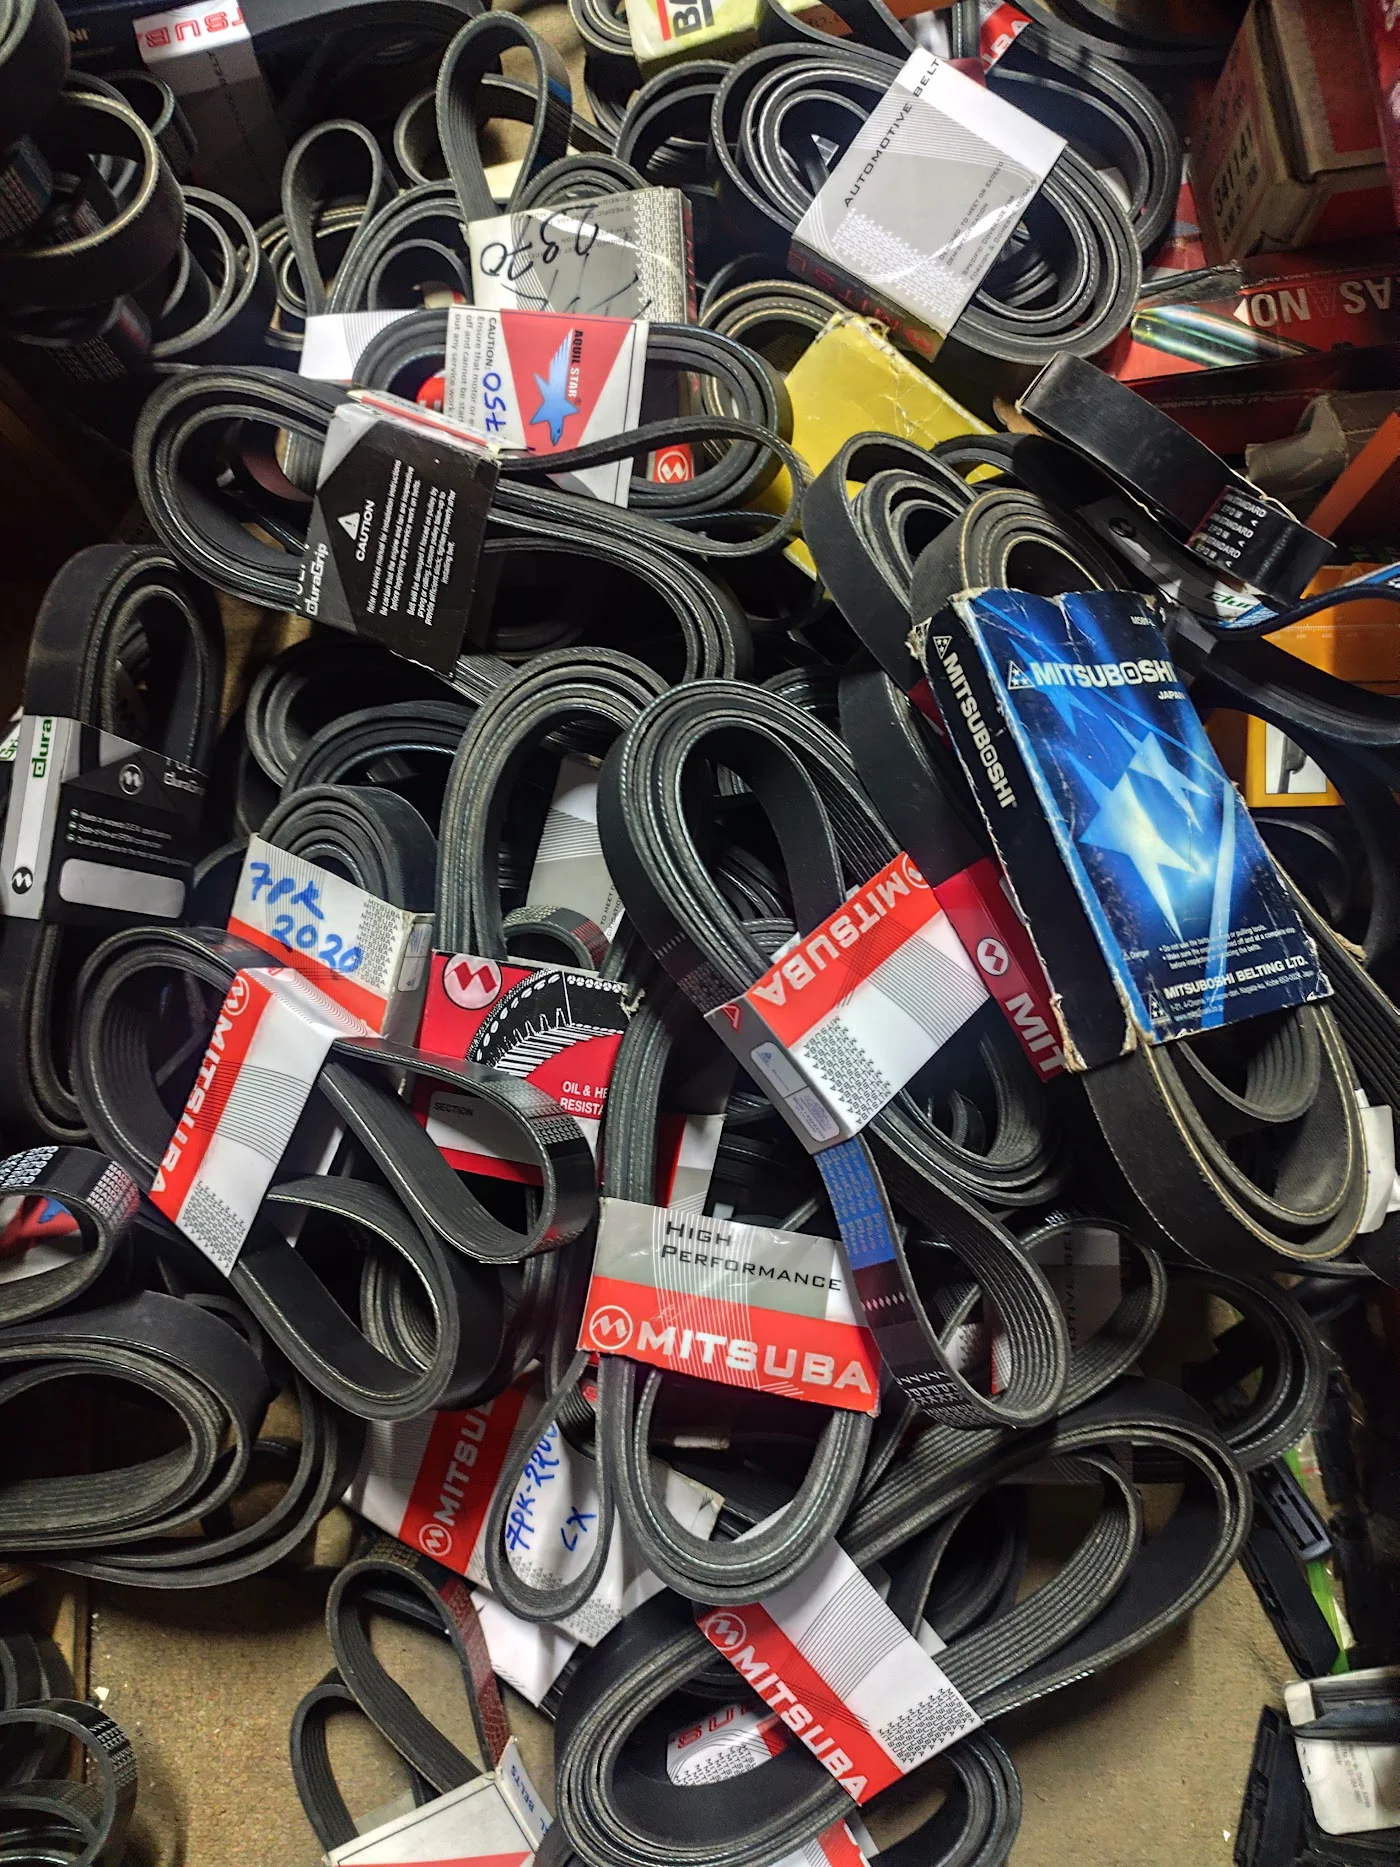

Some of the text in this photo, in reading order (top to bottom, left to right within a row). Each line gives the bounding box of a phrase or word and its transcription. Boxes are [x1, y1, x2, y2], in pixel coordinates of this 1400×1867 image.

[840, 57, 943, 208] AUTOMOTIVE BELT
[959, 216, 969, 227] TO
[966, 198, 981, 218] MEET
[977, 187, 988, 199] OR
[968, 250, 991, 282] FOREIGN
[458, 314, 476, 400] off and cannot be
[483, 317, 499, 371] CAUTION:
[445, 312, 465, 413] out any service work
[468, 315, 487, 417] Ensure that motor or
[567, 329, 585, 398] AQUIL STAR
[381, 498, 395, 533] installation
[406, 507, 416, 525] work
[409, 497, 418, 508] on
[355, 499, 376, 562] CAUTION
[379, 532, 388, 542] for
[401, 523, 413, 548] service
[375, 542, 387, 566] manual
[387, 561, 397, 572] the
[393, 526, 403, 539] and
[412, 552, 426, 583] damaged
[423, 516, 433, 526] on
[304, 542, 331, 615] duraGrip
[369, 588, 378, 596] to
[370, 566, 382, 589] service
[1030, 659, 1178, 688] MITSUBOSHI
[1157, 690, 1186, 700] JAPAN
[31, 717, 54, 779] dura
[941, 651, 1017, 810] MITSUBOSHI
[599, 915, 607, 925] TO
[602, 892, 615, 913] MEET
[269, 910, 368, 978] 2020
[752, 871, 910, 1006] MITSUBA
[1164, 972, 1234, 1000] MITSUBOSHI
[1236, 960, 1285, 982] BELTING
[1285, 954, 1308, 969] LTD.
[562, 1080, 582, 1095] OIL
[583, 1085, 592, 1096] &
[846, 1078, 884, 1115] MITSUBA
[854, 1080, 891, 1116] MITSUBA
[433, 1100, 474, 1118] SECTION
[855, 1089, 892, 1125] MITSUBA
[665, 1221, 733, 1247] HIGH
[661, 1244, 843, 1292] PERFORMANCE
[637, 1321, 873, 1396] MITSUBA
[728, 1642, 872, 1801] MITSUBA
[926, 1701, 955, 1737] MITSUBA
[928, 1695, 958, 1730] MITSUBA
[936, 1695, 965, 1730] MITSUBA
[938, 1688, 968, 1724] MITSUBA
[946, 1688, 976, 1724] MITSUBA
[508, 1764, 536, 1813] BELTS
